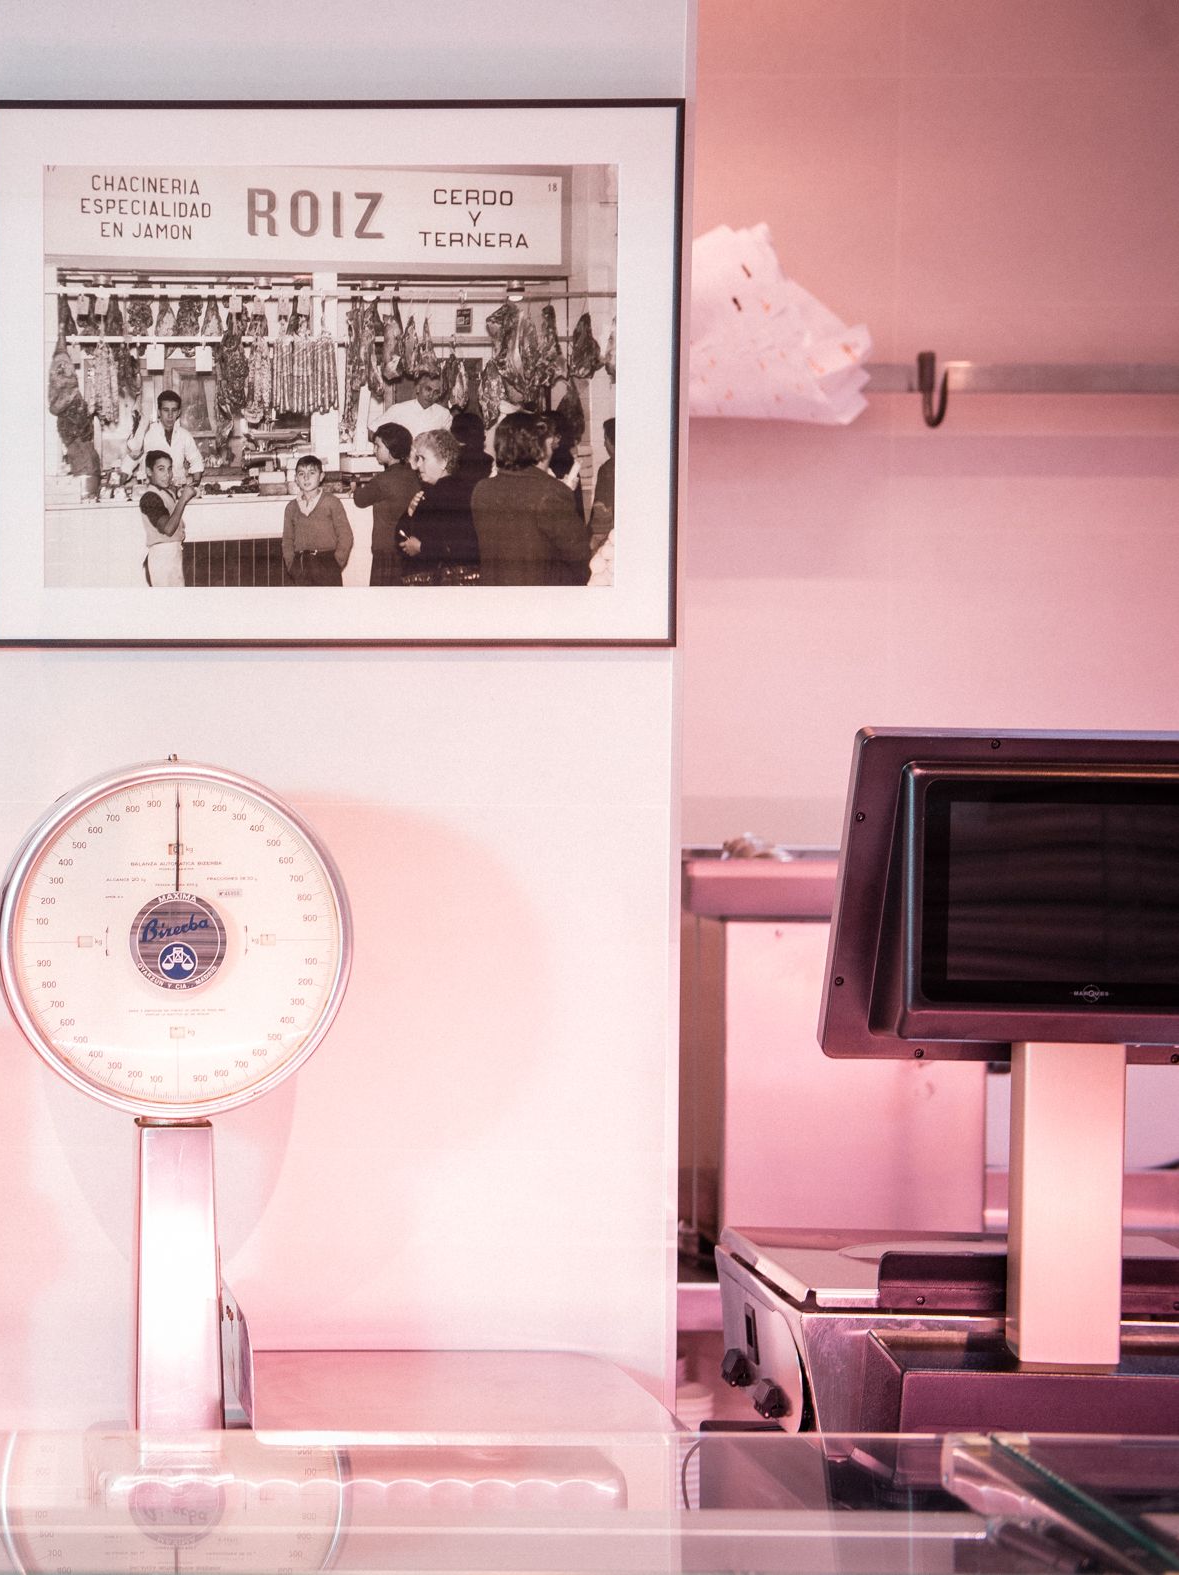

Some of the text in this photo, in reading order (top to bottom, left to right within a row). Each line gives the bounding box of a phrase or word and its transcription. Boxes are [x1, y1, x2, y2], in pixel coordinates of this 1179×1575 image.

[91, 174, 200, 195] CHACINERIA
[548, 182, 558, 192] 18
[433, 188, 514, 206] CERDO
[80, 198, 211, 218] ESPECIALIDAD
[246, 186, 386, 240] ROIZ
[468, 211, 482, 227] Y
[100, 222, 192, 240] EN JAMON
[419, 231, 529, 249] TERNERA
[147, 800, 162, 808] 900
[192, 800, 205, 808] 100
[212, 804, 227, 812] 200
[125, 805, 140, 813] 800
[106, 814, 120, 822] 700
[232, 813, 247, 821] 300
[249, 824, 264, 832] 400
[266, 839, 281, 847] 500
[58, 858, 73, 866] 400
[278, 856, 294, 864] 600
[158, 892, 197, 903] MAXIMA
[302, 914, 318, 922] 900
[141, 913, 210, 942] Bizerba
[36, 959, 52, 967] 900
[304, 957, 318, 965] 100
[137, 962, 164, 986] OYARZUN
[194, 966, 218, 986] MADRID
[298, 978, 313, 986] 200
[50, 1000, 65, 1008] 700
[290, 998, 305, 1006] 300
[60, 1018, 75, 1026] 600
[279, 1016, 295, 1024] 400
[73, 1036, 88, 1044] 500
[267, 1033, 282, 1041] 500
[107, 1062, 122, 1070] 300
[234, 1060, 249, 1068] 700
[127, 1070, 143, 1078] 200
[192, 1074, 208, 1082] 900
[150, 1075, 163, 1083] 100
